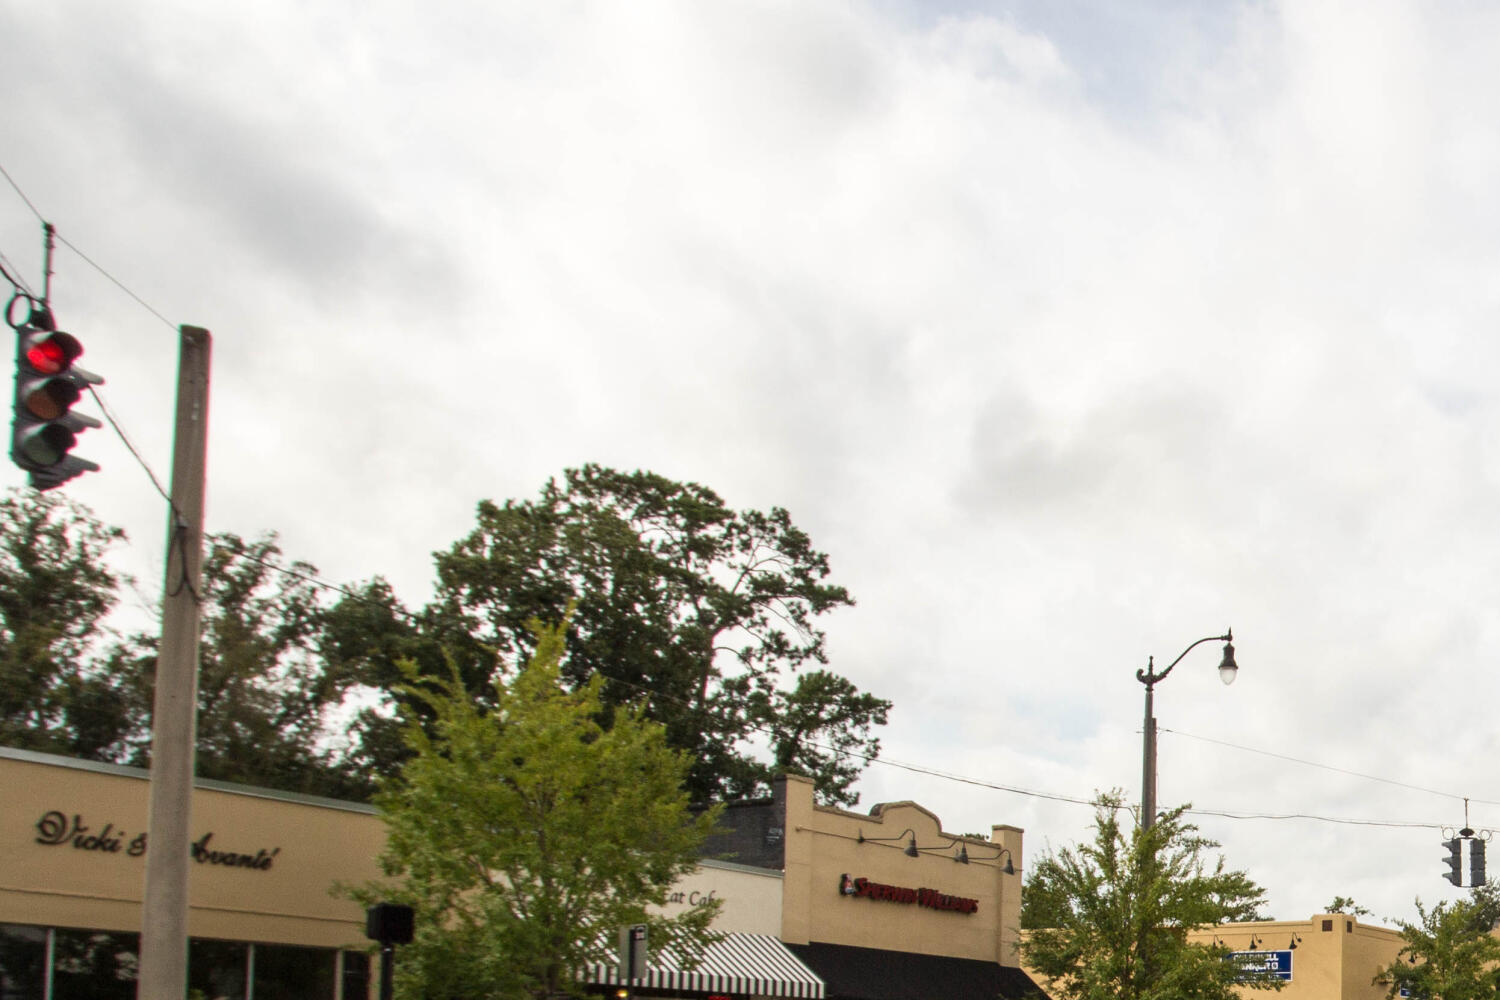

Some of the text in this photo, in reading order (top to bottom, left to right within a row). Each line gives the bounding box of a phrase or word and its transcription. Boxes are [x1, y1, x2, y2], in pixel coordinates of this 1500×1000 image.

[34, 811, 126, 853] Vicki
[126, 832, 147, 857] &
[689, 890, 718, 907] Caf
